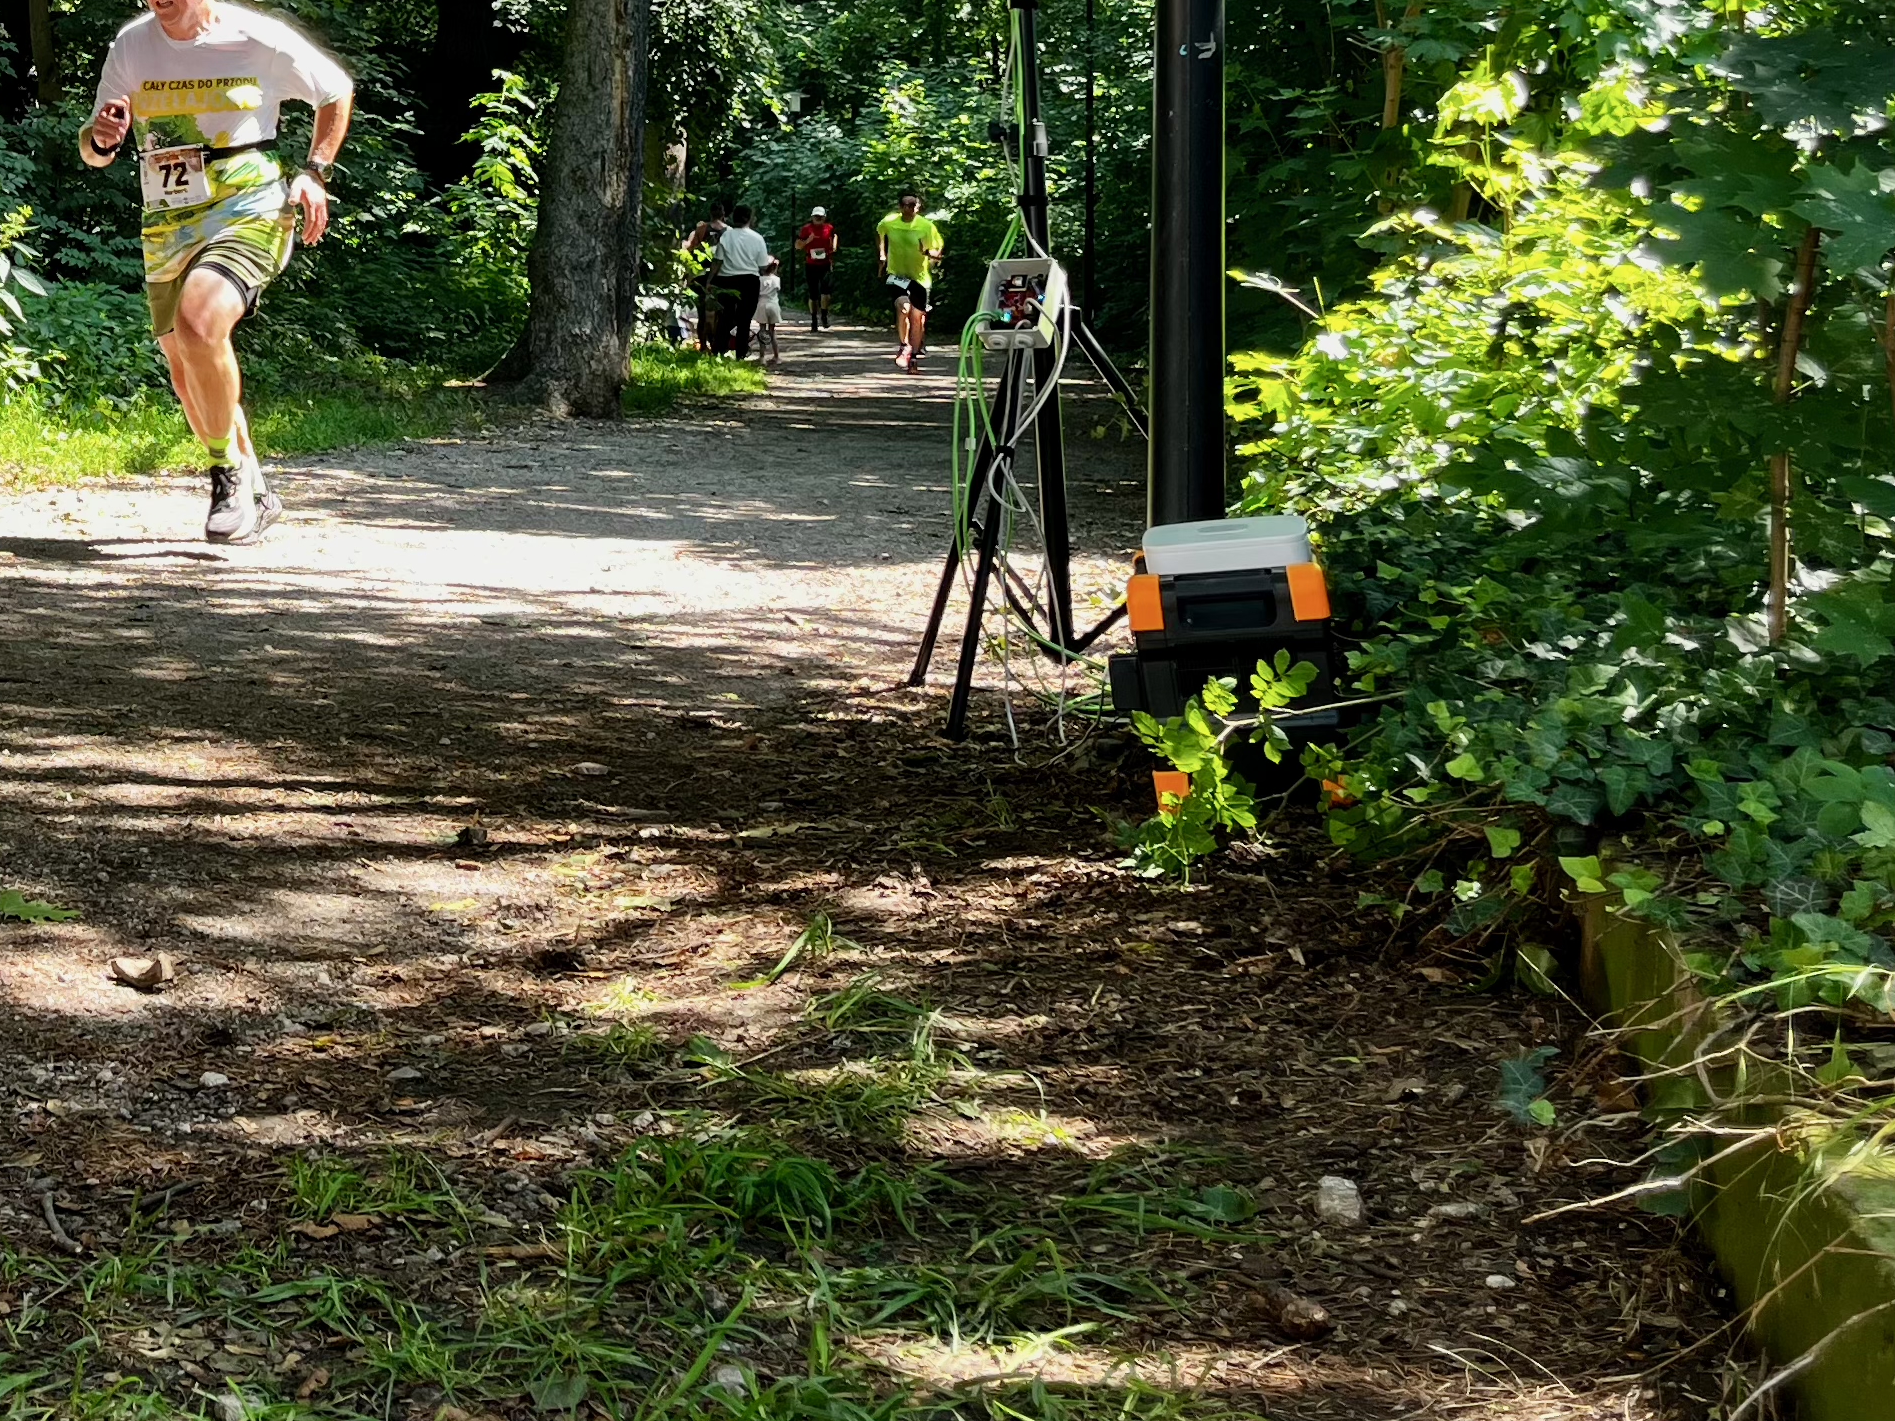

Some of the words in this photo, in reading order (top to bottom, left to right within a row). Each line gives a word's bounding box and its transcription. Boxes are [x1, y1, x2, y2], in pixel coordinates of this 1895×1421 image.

[143, 80, 167, 91] CAŁY
[168, 80, 195, 90] CZAS
[197, 79, 213, 89] DO
[216, 78, 258, 87] PRZODU
[159, 162, 189, 188] 72
